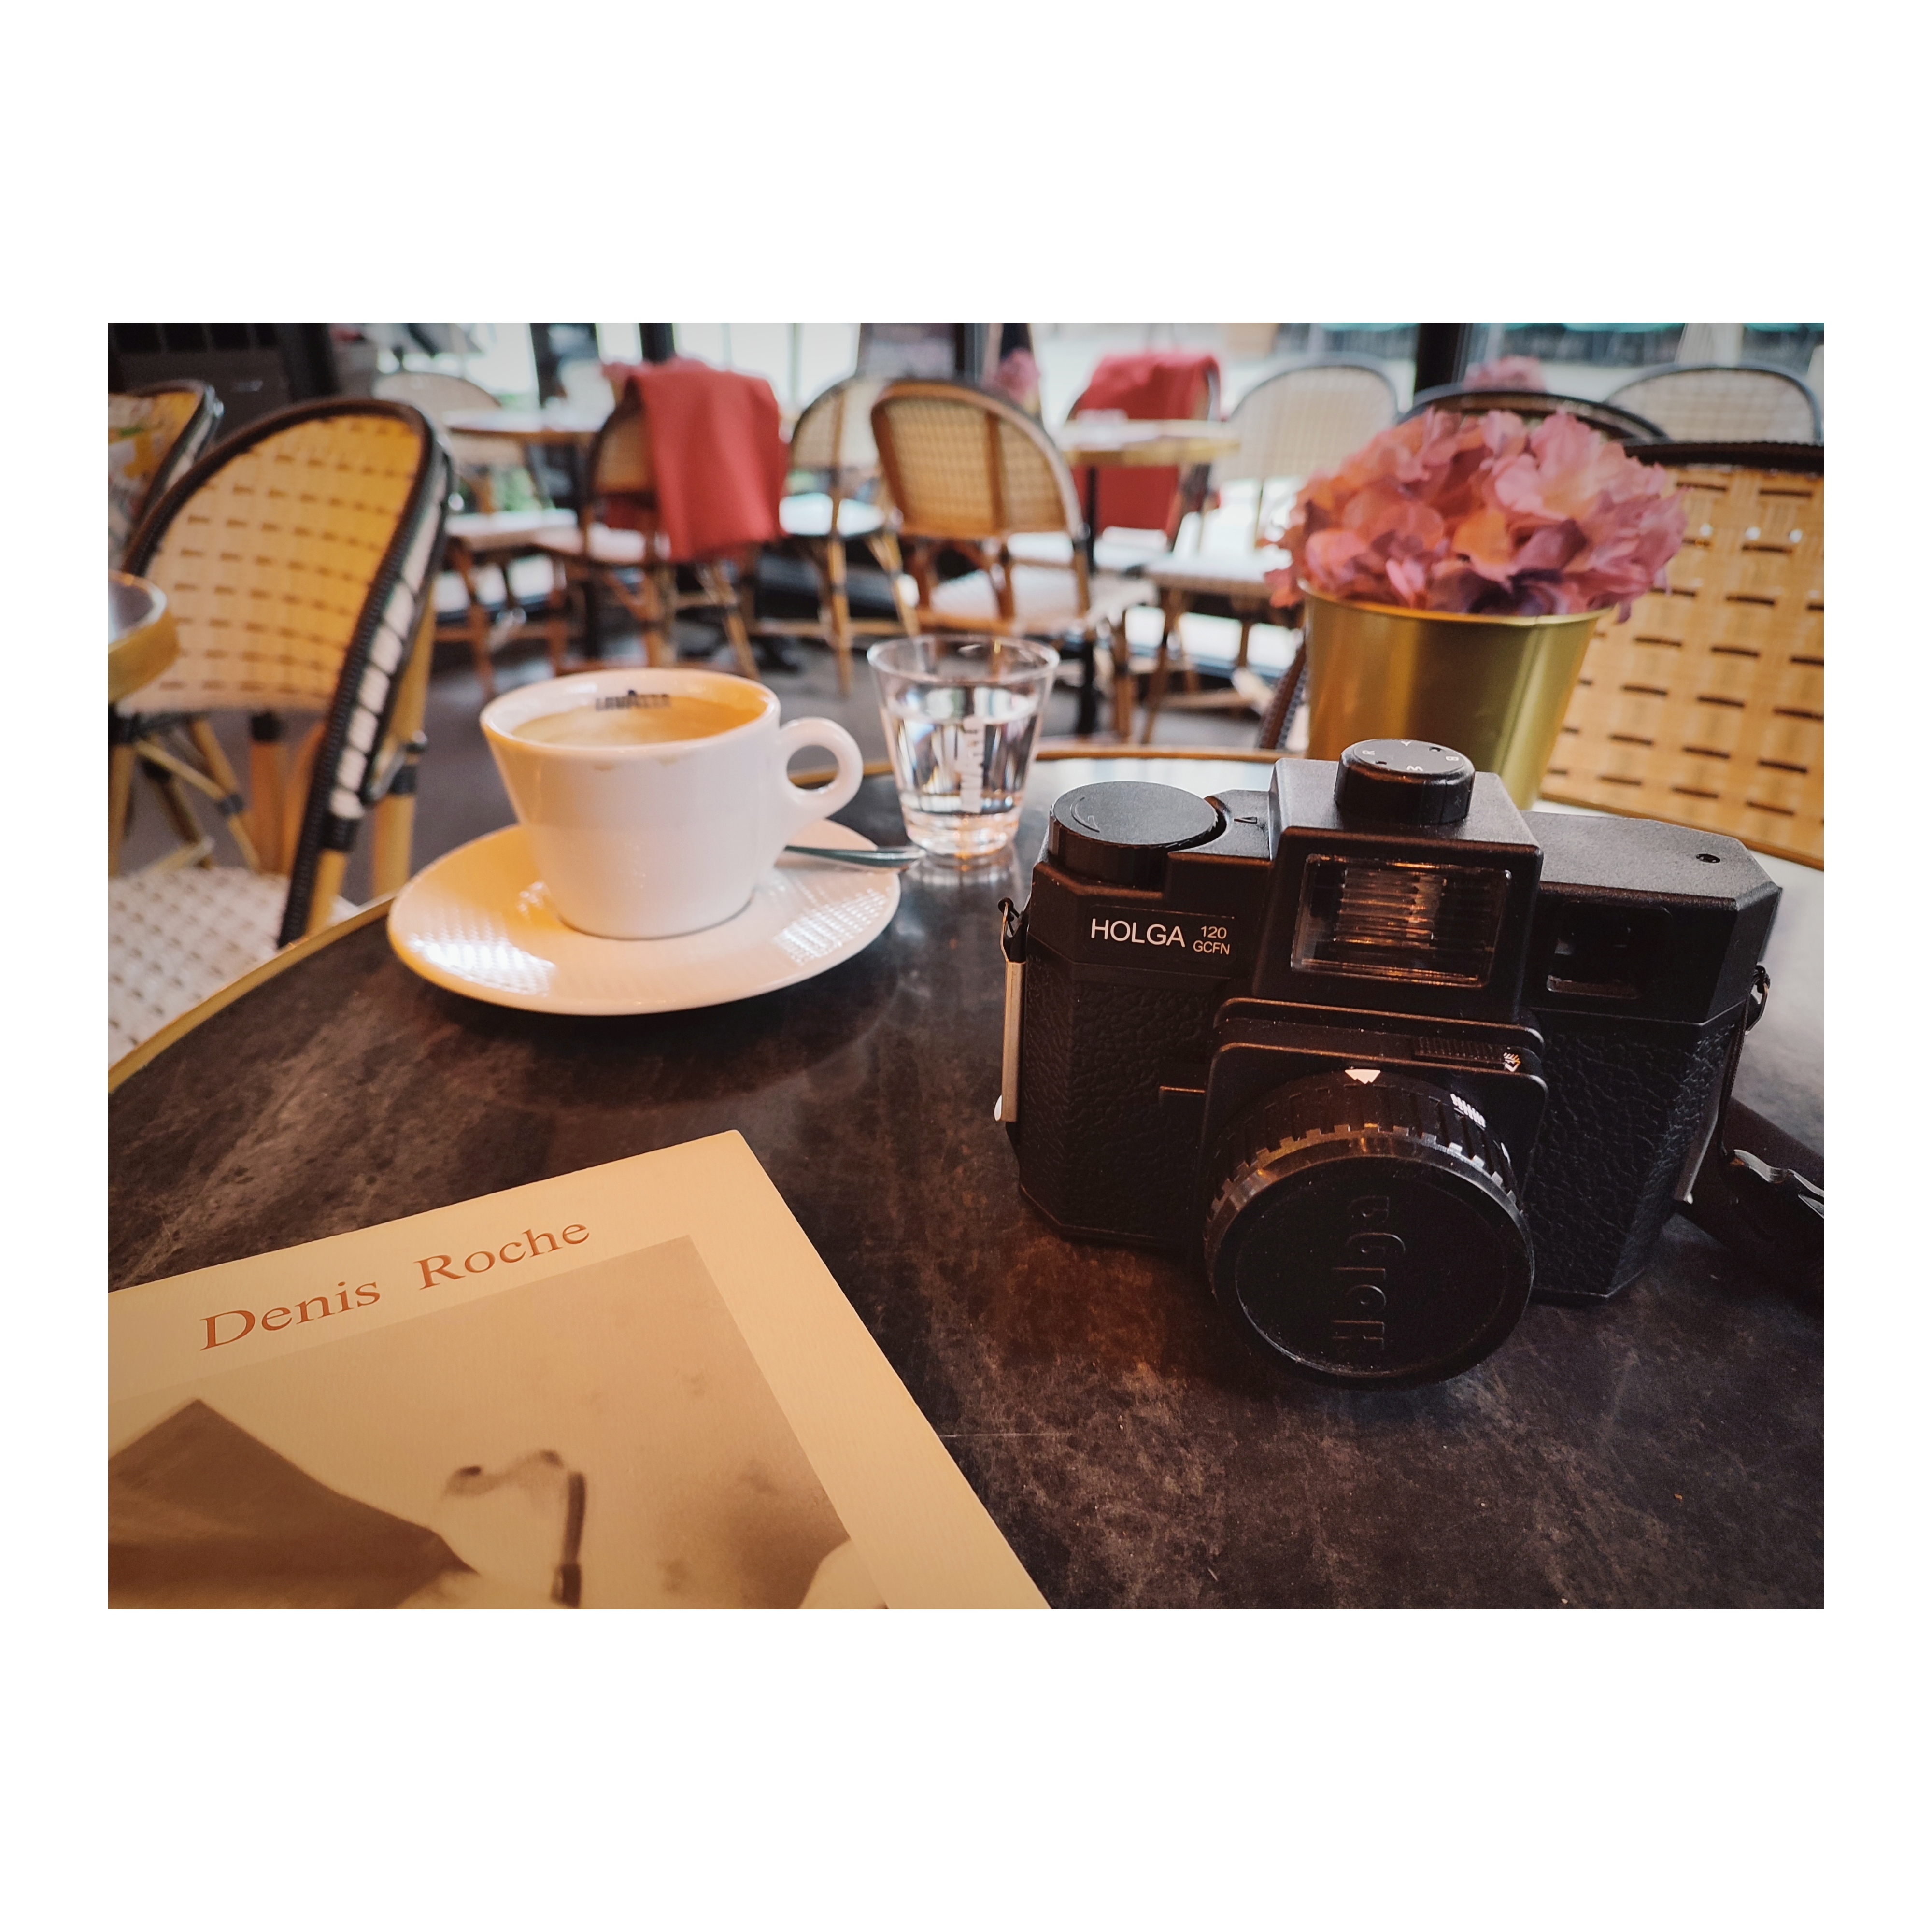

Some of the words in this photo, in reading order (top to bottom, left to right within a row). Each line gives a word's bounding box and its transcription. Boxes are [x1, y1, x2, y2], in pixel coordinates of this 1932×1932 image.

[1091, 918, 1185, 948] HOLGA
[1200, 925, 1227, 939] 120
[1193, 940, 1230, 955] GCFN
[199, 1281, 381, 1351] Denis
[413, 1223, 590, 1291] Roche
